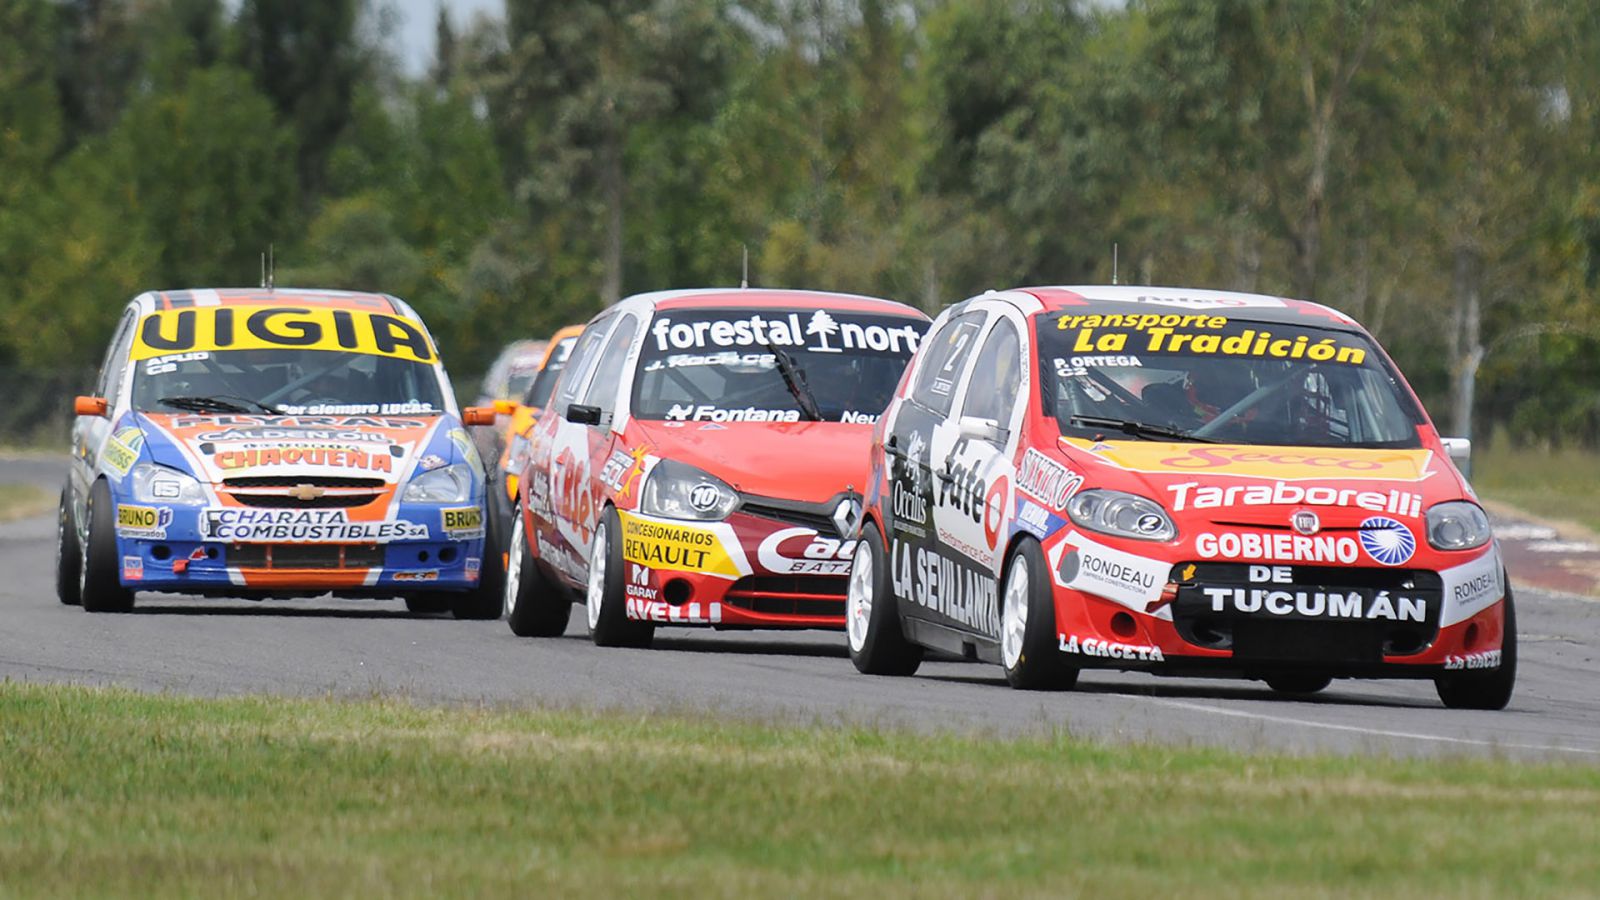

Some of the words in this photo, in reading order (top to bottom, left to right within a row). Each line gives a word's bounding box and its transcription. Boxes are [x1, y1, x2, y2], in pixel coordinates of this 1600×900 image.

[1056, 313, 1228, 331] transporte
[652, 313, 804, 351] forestal
[841, 324, 926, 354] nort
[1073, 328, 1128, 352] La
[1147, 327, 1366, 365] Tradición
[1054, 357, 1069, 369] P.
[1070, 355, 1143, 367] ORTEGA
[1057, 367, 1088, 377] C2
[308, 403, 379, 416] siempre
[693, 405, 801, 422] Fontana
[1159, 446, 1384, 470] Secco
[693, 486, 716, 506] 10
[1167, 481, 1422, 518] Taraborelli
[118, 509, 156, 526] BRUNO
[219, 510, 345, 524] CHARATA
[1141, 514, 1160, 530] 2
[216, 523, 408, 539] COMBUSTIBLES
[627, 521, 714, 547] CONCESIONARIOS
[625, 538, 711, 569] RENAULT
[1196, 533, 1359, 565] GOBIERNO
[892, 538, 914, 602] LA
[1082, 554, 1155, 589] RONDEAU
[1249, 565, 1293, 584] DE
[626, 584, 658, 599] GARAY
[626, 597, 722, 623] AVELLI
[1203, 588, 1427, 623] TUCUMÁN
[1058, 633, 1080, 654] LA
[1081, 637, 1165, 662] GACETA
